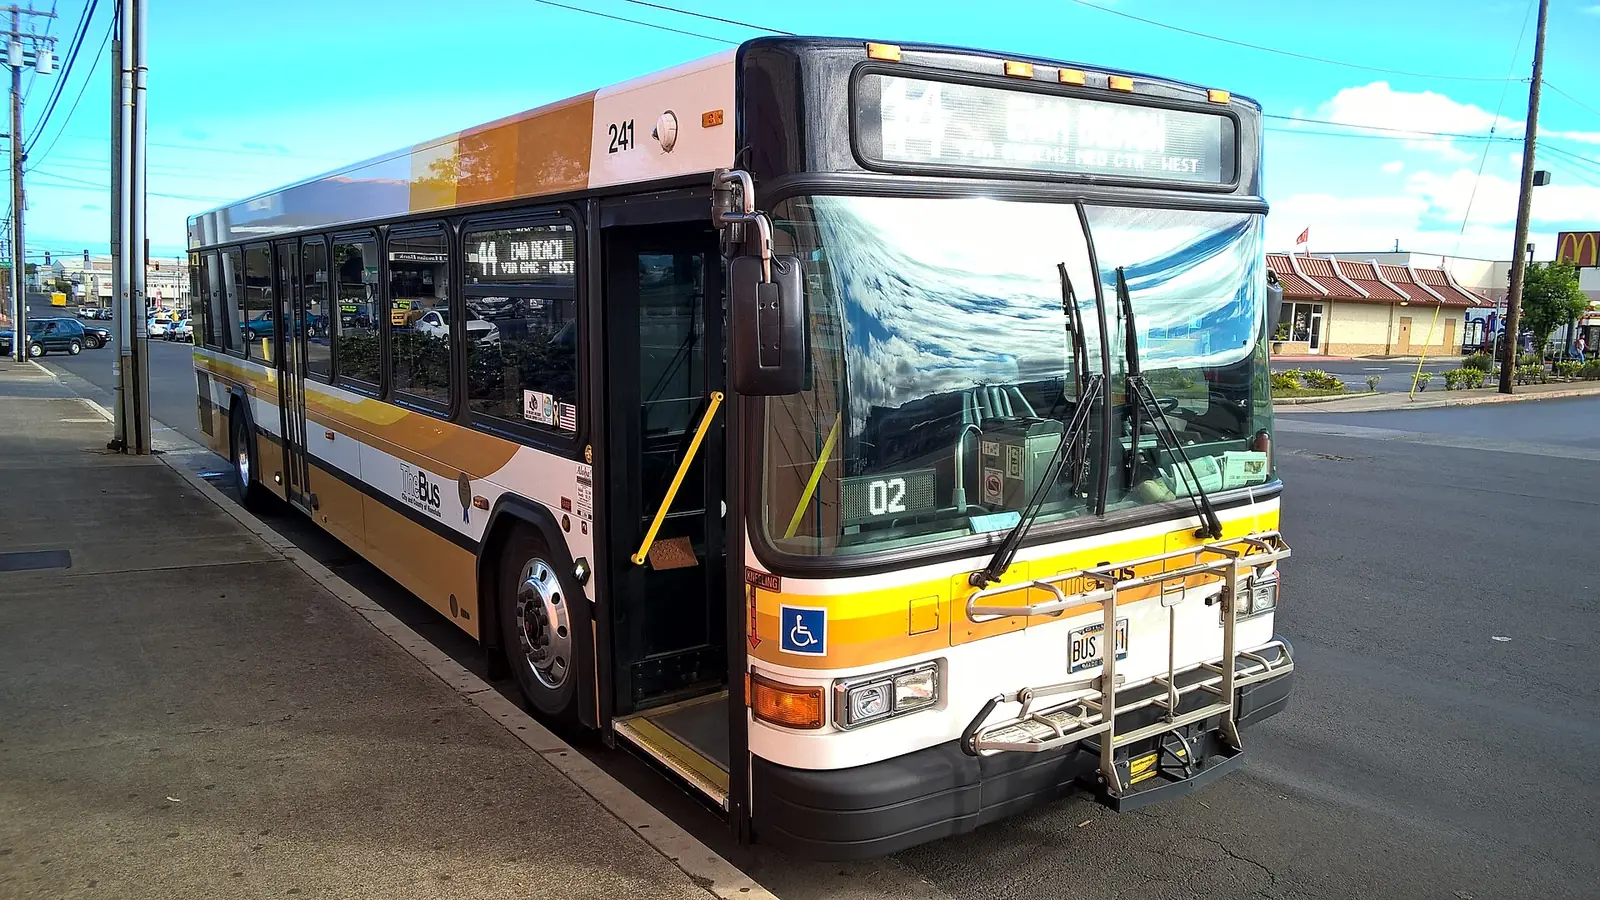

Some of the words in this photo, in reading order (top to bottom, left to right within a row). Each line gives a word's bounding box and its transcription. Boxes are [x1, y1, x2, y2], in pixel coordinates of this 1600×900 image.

[608, 119, 634, 153] 241
[1161, 156, 1200, 174] WEST
[478, 241, 498, 276] 44
[531, 239, 563, 260] BEACH
[548, 260, 575, 274] WEST
[869, 477, 906, 516] 02
[1072, 635, 1097, 663] BUS
